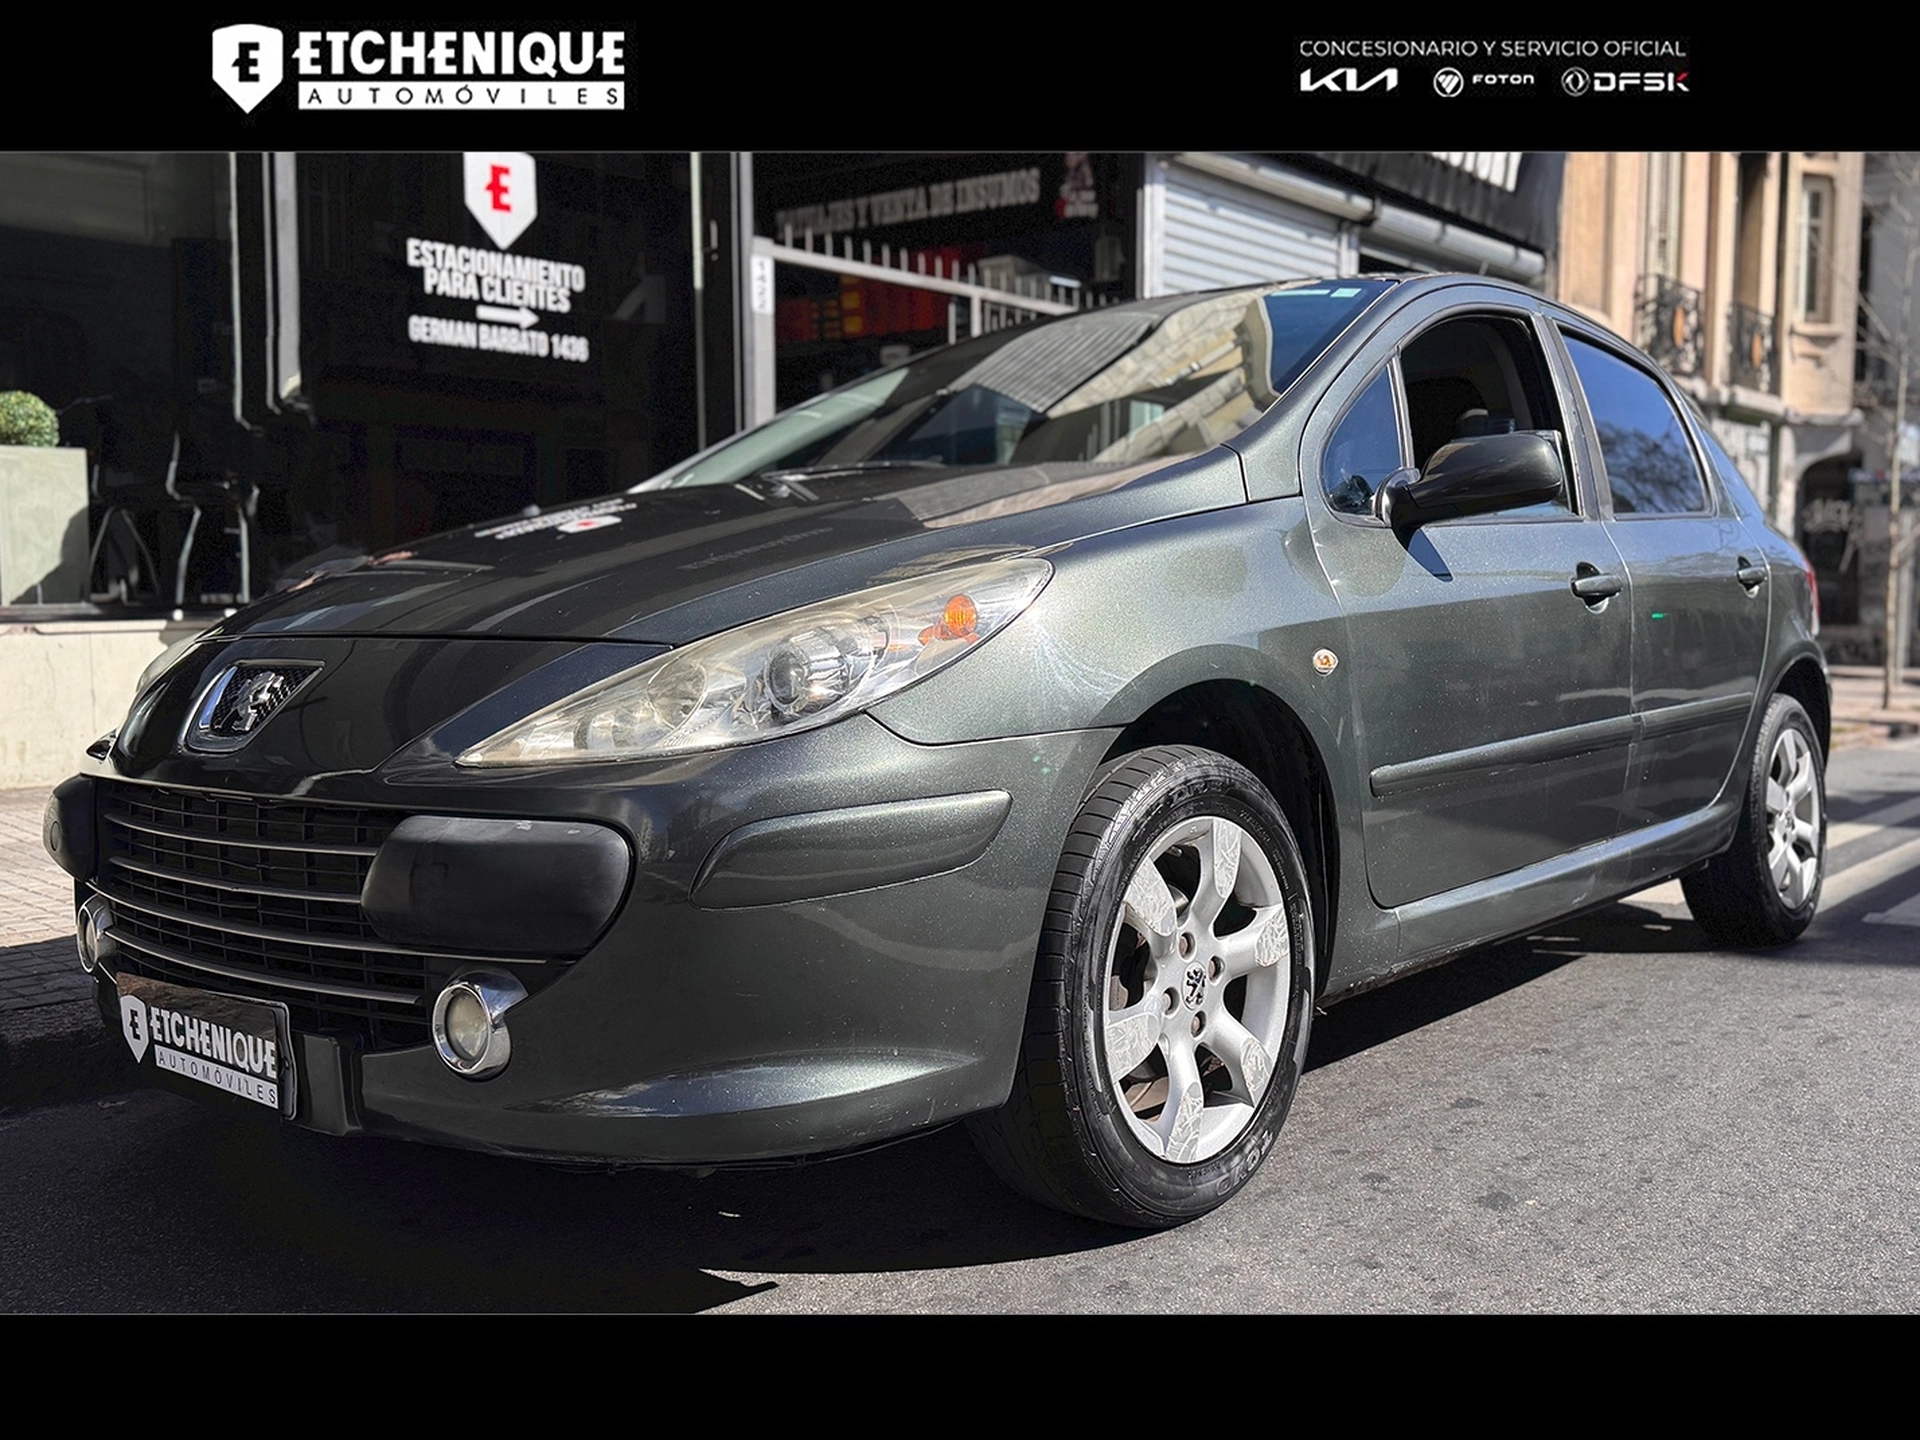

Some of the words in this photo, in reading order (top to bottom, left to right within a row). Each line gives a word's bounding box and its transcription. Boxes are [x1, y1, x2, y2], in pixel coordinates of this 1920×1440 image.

[407, 238, 585, 292] ESTACIONAMIENTO
[425, 268, 480, 300] PARA
[482, 276, 571, 313] CLIENTES
[408, 314, 477, 349] GERMAN
[478, 324, 549, 358] BARBATO
[150, 1006, 278, 1079] ETCHENIQUE
[157, 1050, 277, 1105] AUTOMÓVILES
